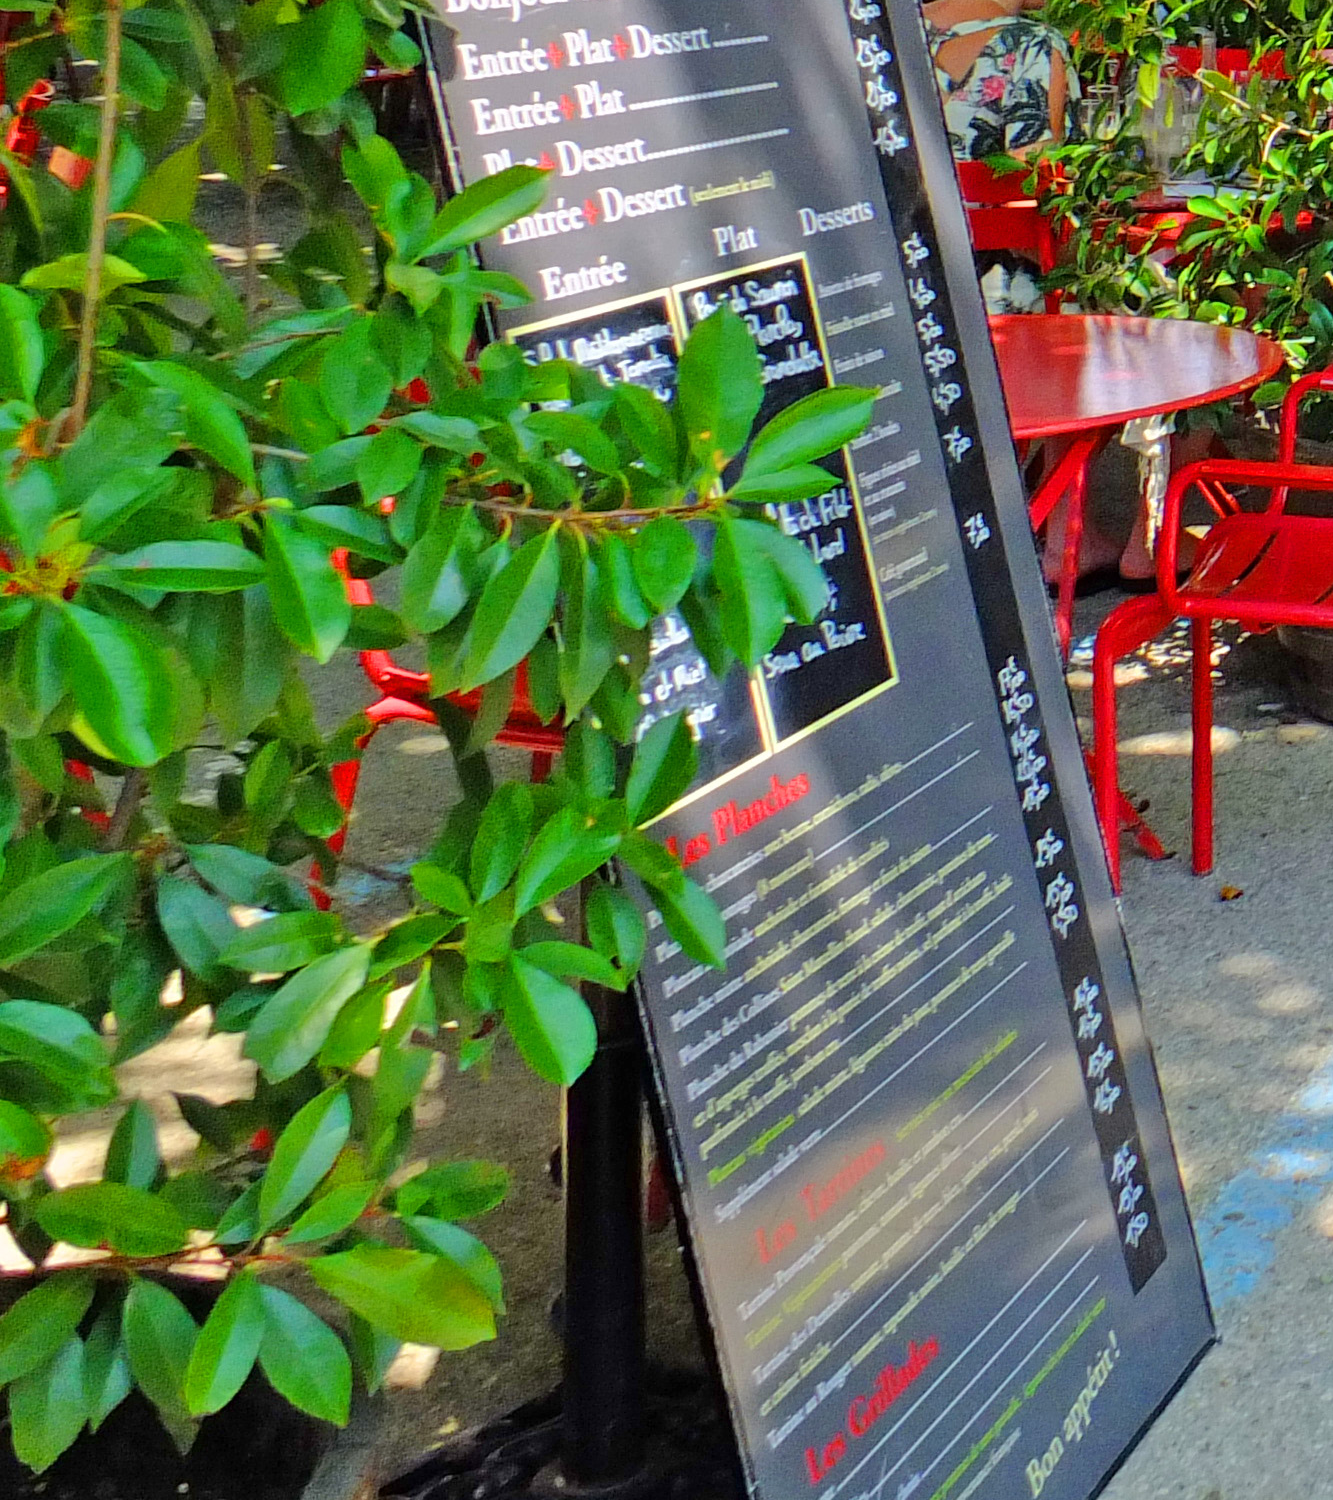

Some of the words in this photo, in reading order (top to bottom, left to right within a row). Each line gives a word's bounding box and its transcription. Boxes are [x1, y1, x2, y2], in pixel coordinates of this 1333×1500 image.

[712, 224, 758, 256] Plat
[799, 200, 875, 238] Desserts
[540, 254, 628, 301] Entrée
[1025, 1434, 1063, 1495] Bon
